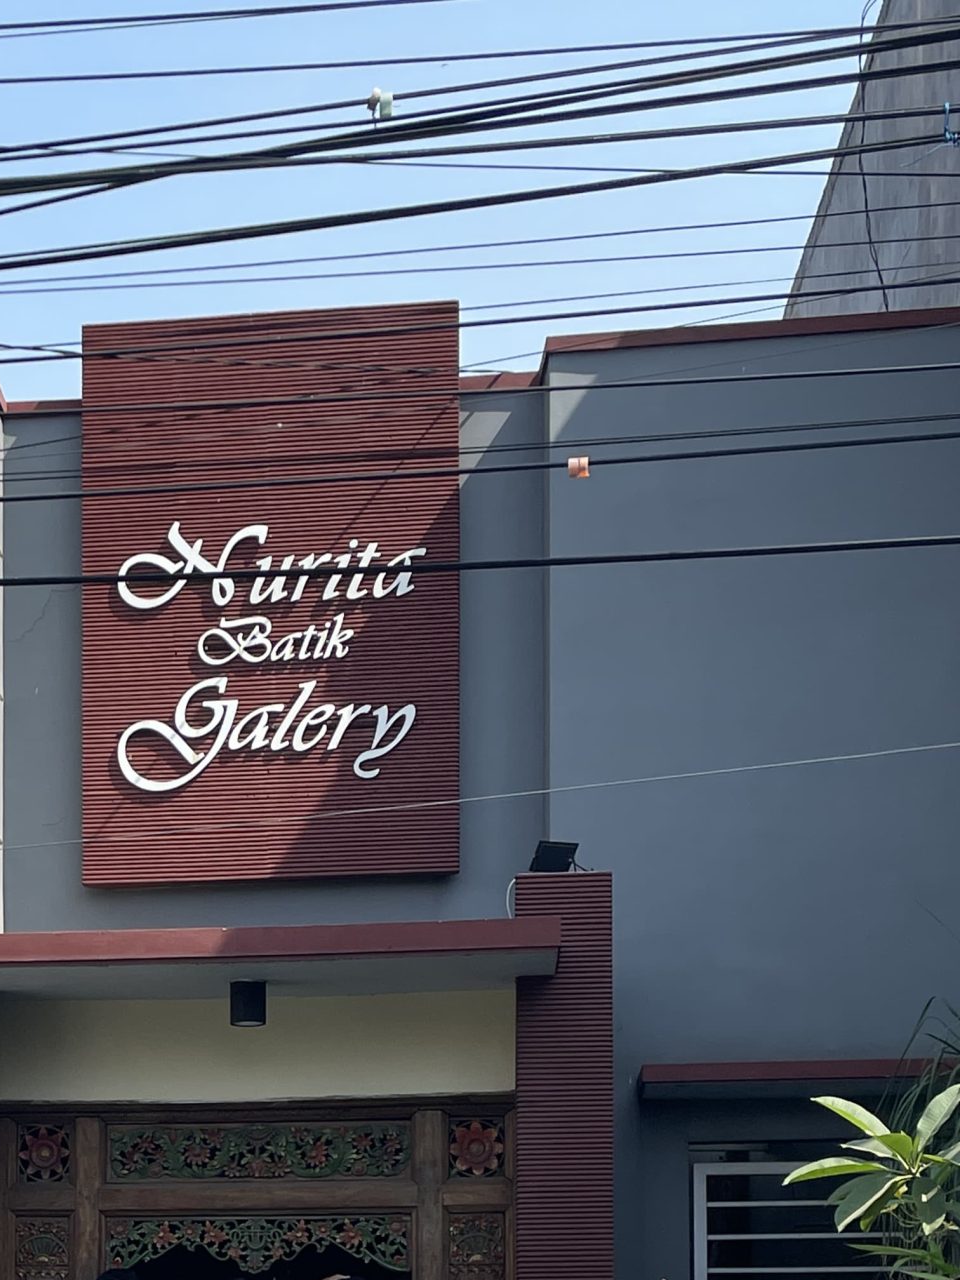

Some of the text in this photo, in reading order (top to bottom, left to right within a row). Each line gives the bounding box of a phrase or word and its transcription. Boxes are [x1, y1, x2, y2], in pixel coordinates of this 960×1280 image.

[117, 521, 427, 609] Nurita
[197, 612, 354, 666] Batik
[117, 677, 417, 792] Galery
